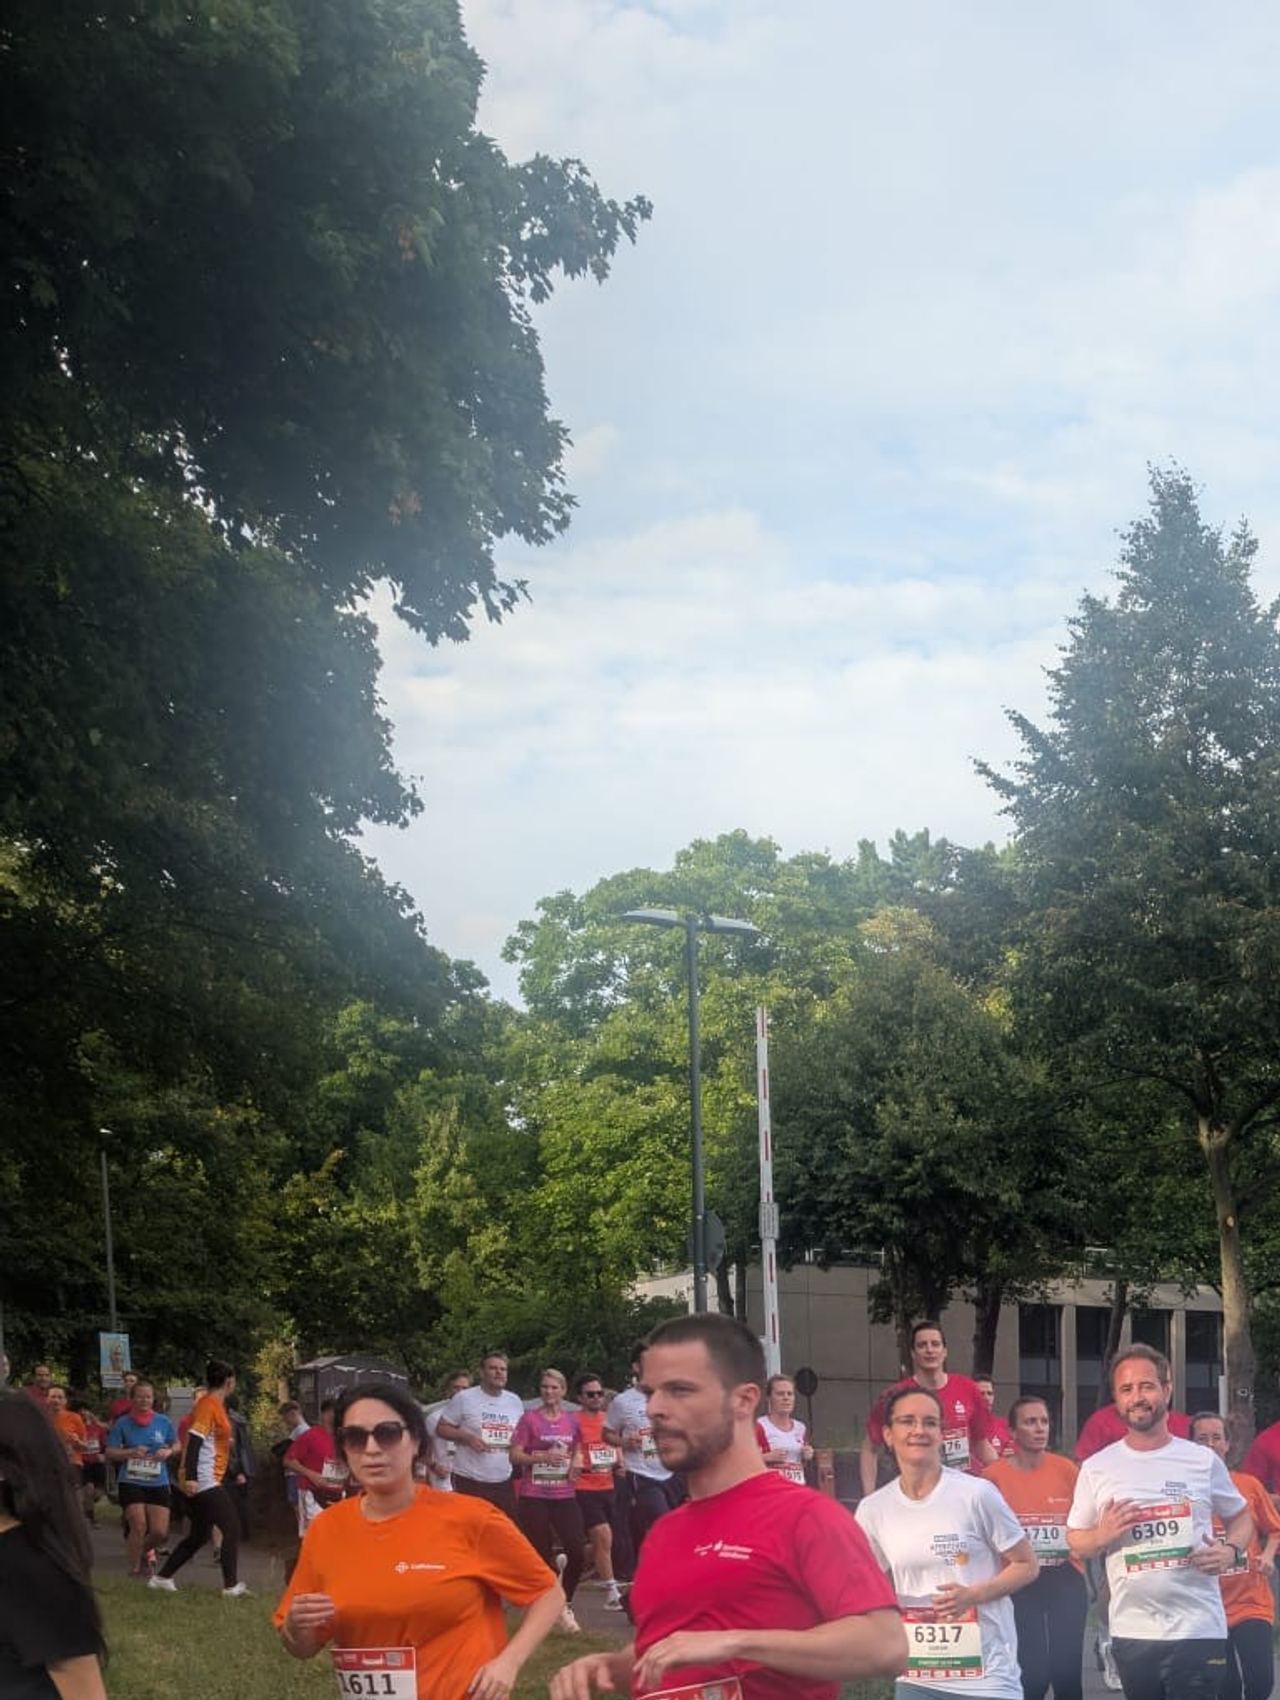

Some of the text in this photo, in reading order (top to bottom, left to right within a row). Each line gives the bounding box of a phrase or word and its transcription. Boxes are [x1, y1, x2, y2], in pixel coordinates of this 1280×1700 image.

[1131, 1520, 1179, 1541] 6309
[914, 1626, 963, 1643] 6317
[339, 1673, 396, 1695] 1611
